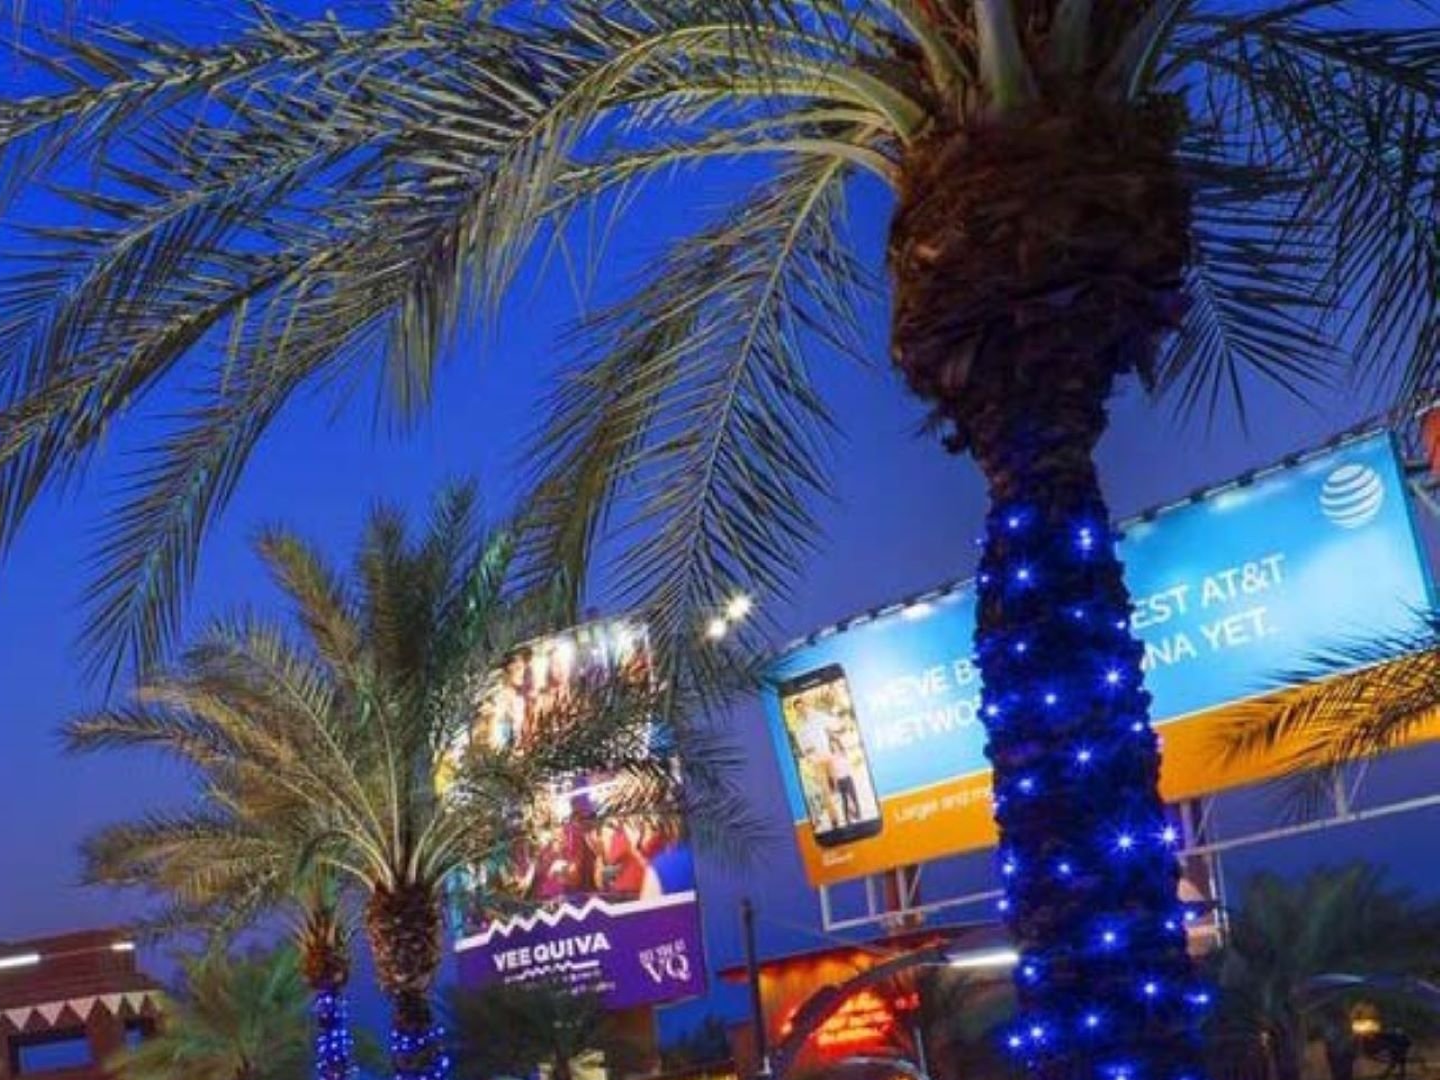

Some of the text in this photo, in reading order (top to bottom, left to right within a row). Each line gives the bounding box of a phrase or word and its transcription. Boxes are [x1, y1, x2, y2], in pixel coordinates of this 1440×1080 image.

[1200, 553, 1285, 608] AT&T
[1200, 605, 1280, 650] YET.
[876, 695, 982, 748] NETWO
[493, 947, 532, 972] VEE
[533, 931, 611, 963] QUIVA
[642, 954, 692, 984] VQ
